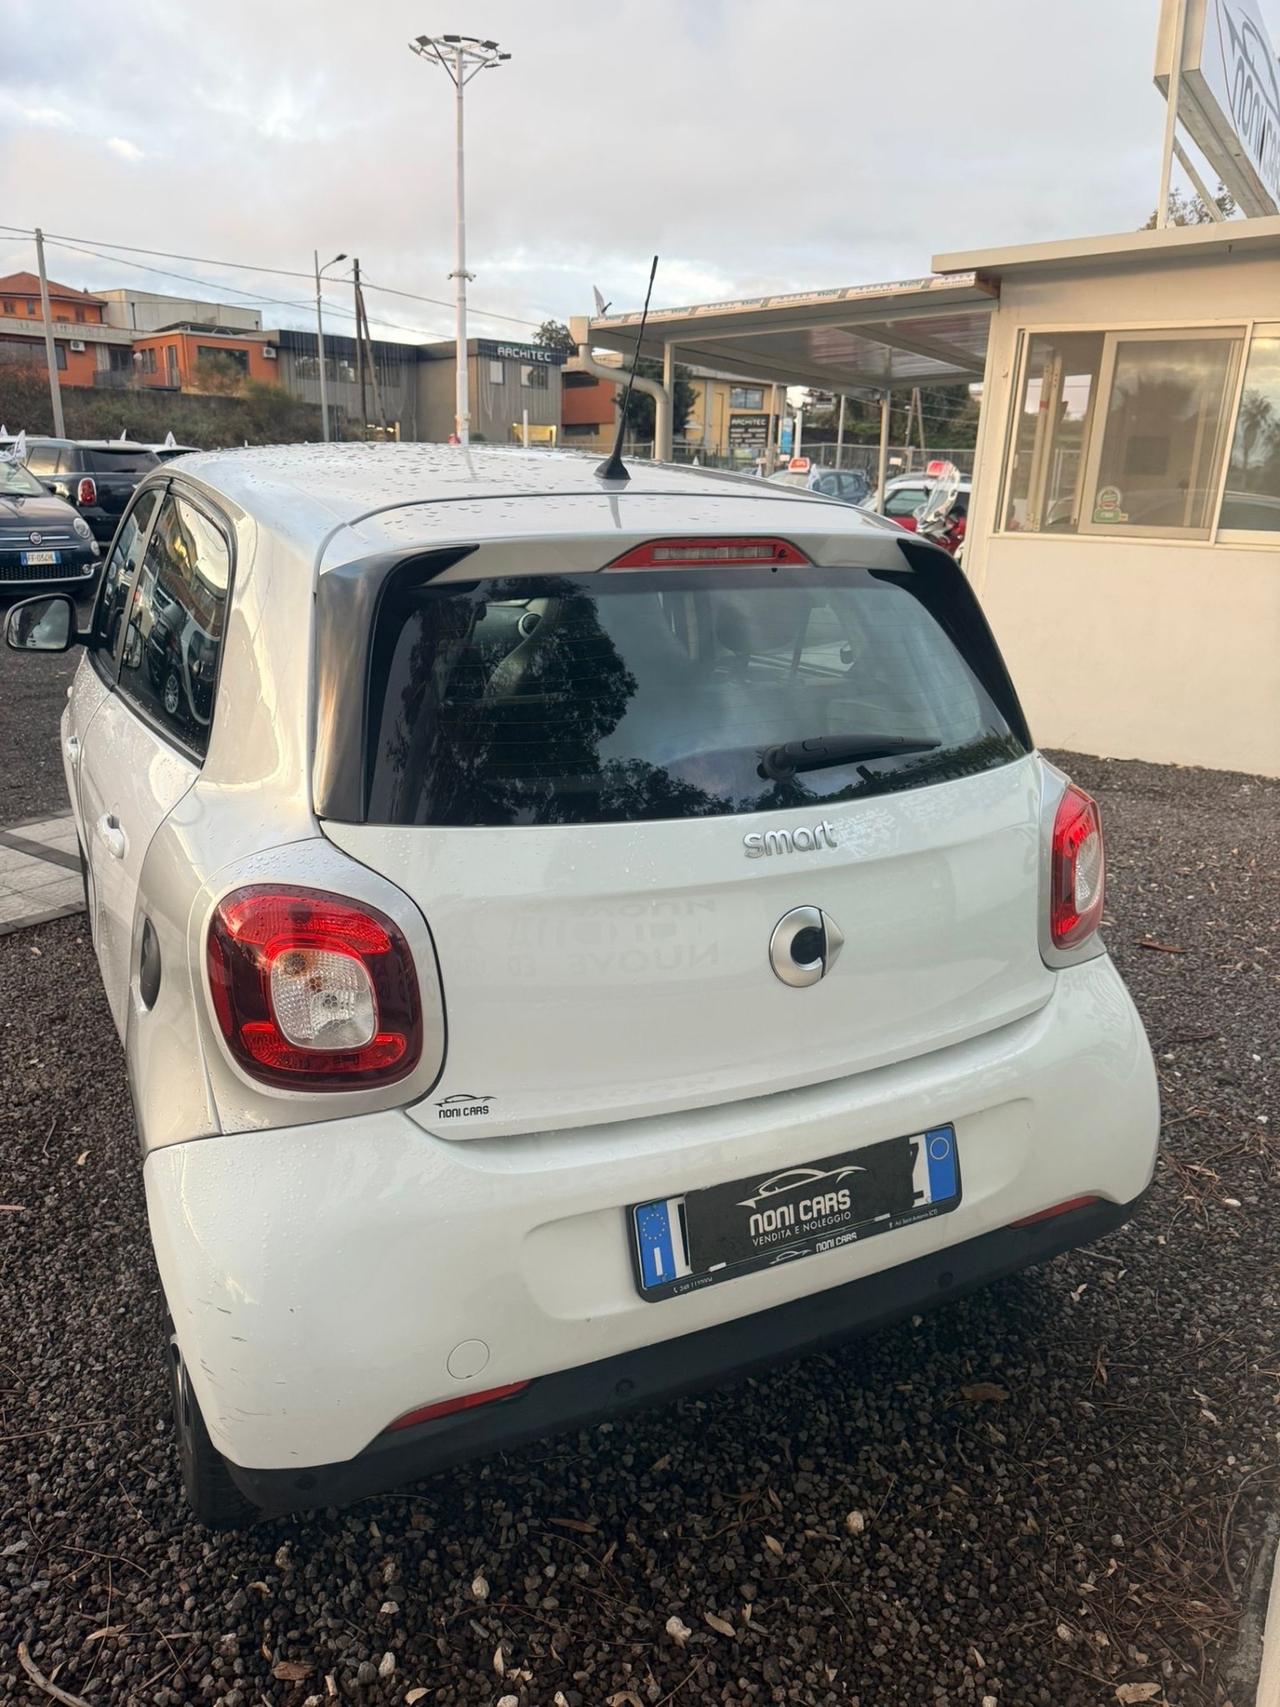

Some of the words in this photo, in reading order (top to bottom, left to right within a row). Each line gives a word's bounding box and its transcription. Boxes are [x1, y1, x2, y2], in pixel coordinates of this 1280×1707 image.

[497, 347, 552, 362] ARCHITEC
[731, 418, 767, 427] ARCHITEC
[743, 820, 838, 859] smart
[438, 1108, 461, 1119] NONI
[463, 1105, 489, 1116] CARS
[749, 1203, 795, 1236] NONI
[799, 1189, 851, 1221] CARS
[752, 1229, 792, 1247] VENDITA
[794, 1225, 800, 1235] E
[803, 1211, 851, 1232] NOLEGGIO
[815, 1238, 834, 1253] NONI
[835, 1231, 857, 1246] CARS
